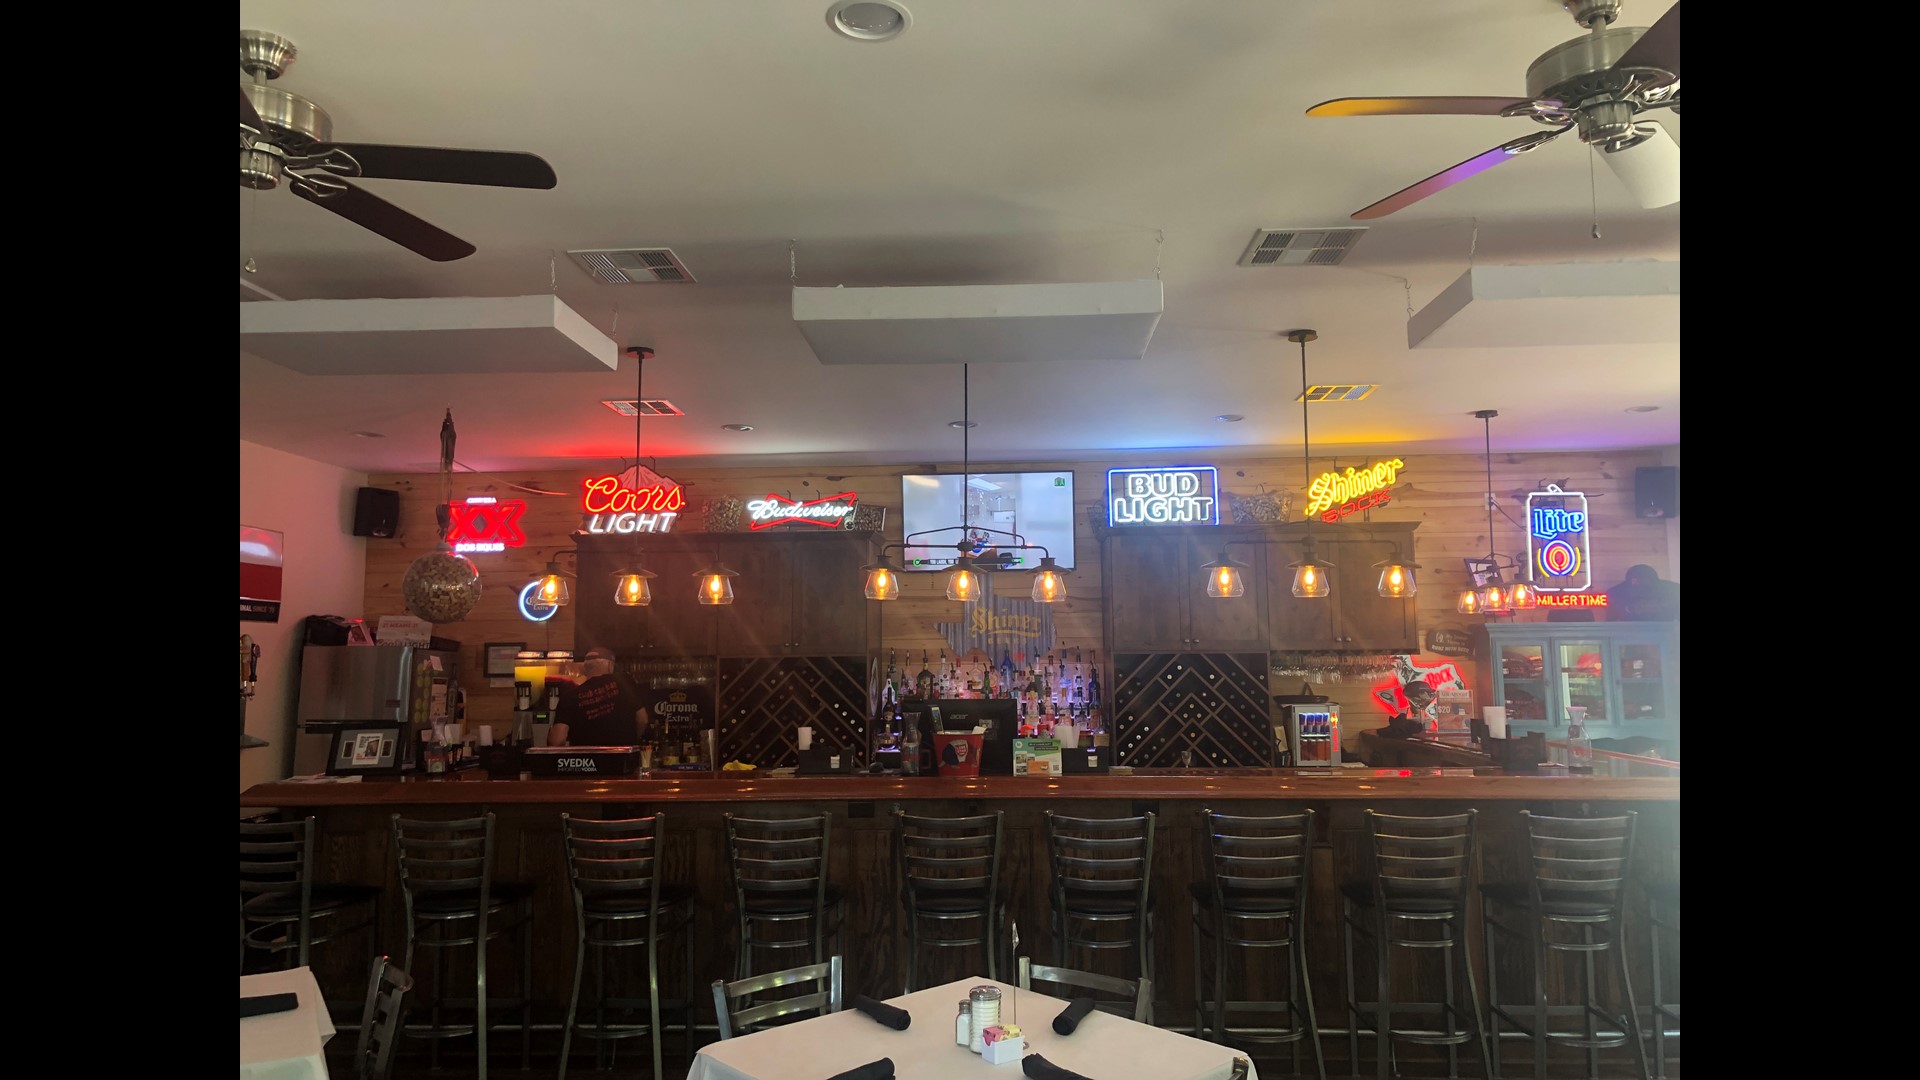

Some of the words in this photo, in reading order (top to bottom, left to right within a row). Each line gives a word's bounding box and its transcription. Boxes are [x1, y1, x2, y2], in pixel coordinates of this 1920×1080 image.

[585, 477, 684, 513] Coors
[1128, 472, 1199, 498] BUD
[1305, 458, 1404, 516] Shiner
[590, 512, 677, 533] LIGHT
[748, 499, 854, 520] Budweiser
[1114, 497, 1214, 523] LIGHT
[446, 503, 522, 543] XX
[1533, 508, 1584, 540] Lite
[1537, 595, 1577, 606] MILLER
[1578, 594, 1608, 606] TIME
[970, 608, 1041, 638] Shiner
[654, 702, 698, 716] Corona
[557, 758, 595, 768] SVEDKA
